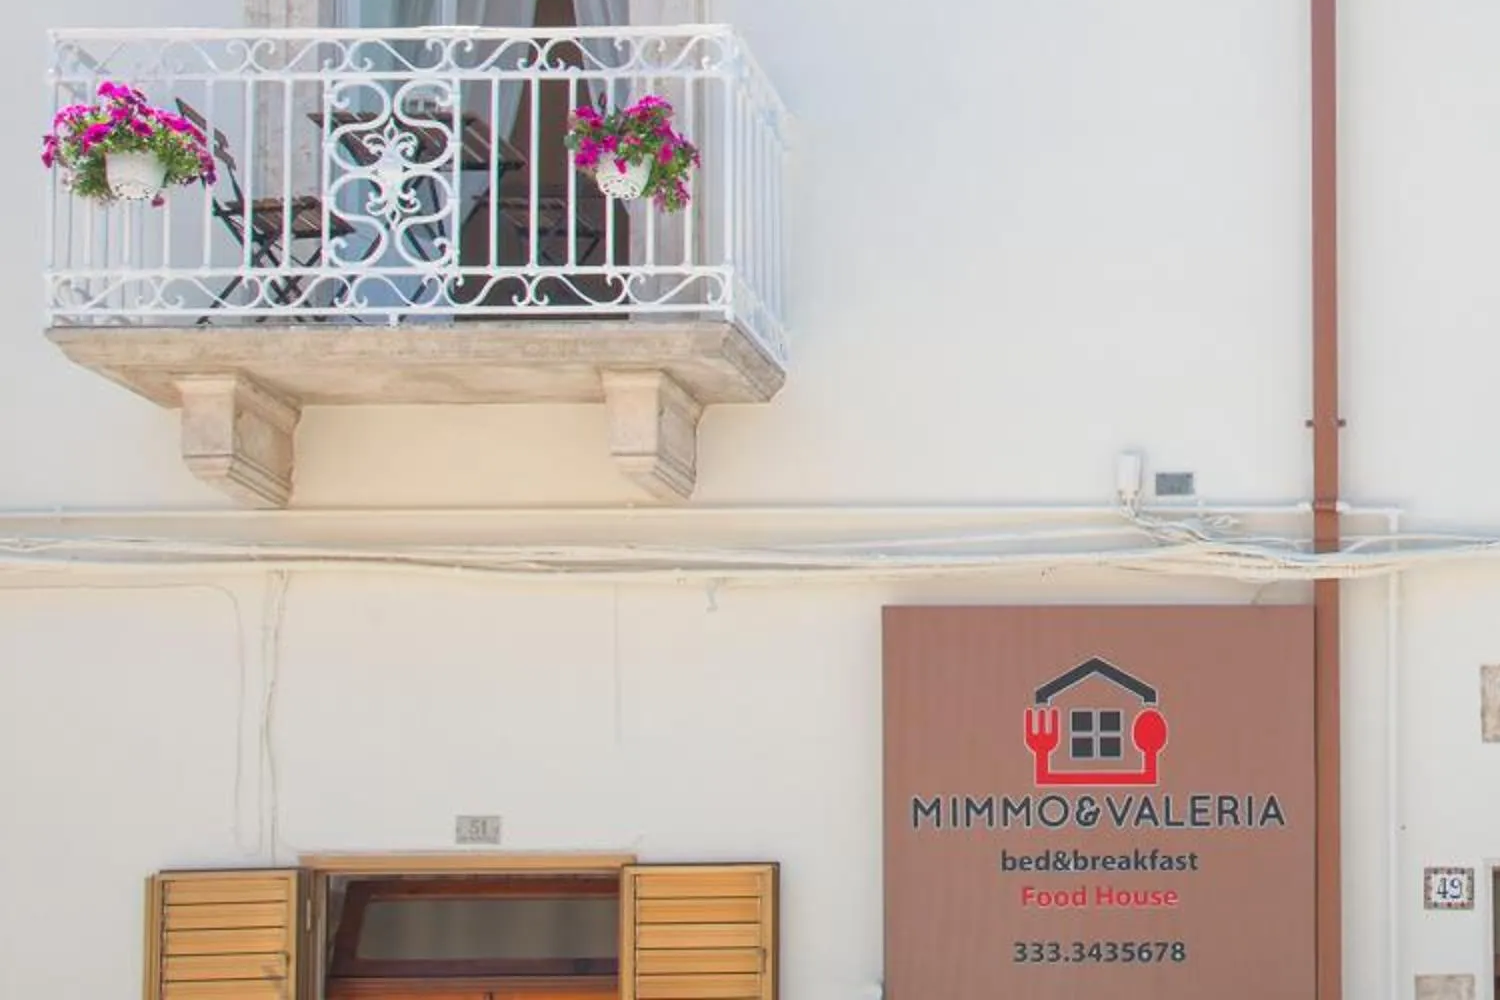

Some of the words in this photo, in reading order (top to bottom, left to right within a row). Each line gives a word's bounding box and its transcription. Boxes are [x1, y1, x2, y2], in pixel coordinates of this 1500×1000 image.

[912, 796, 1285, 828] MIMMO&VALERIA
[1000, 849, 1199, 871] bed&breakfast
[1021, 886, 1087, 907] Food
[1095, 886, 1179, 907] House
[1436, 877, 1464, 899] 49
[1013, 942, 1186, 963] 333.3435678
